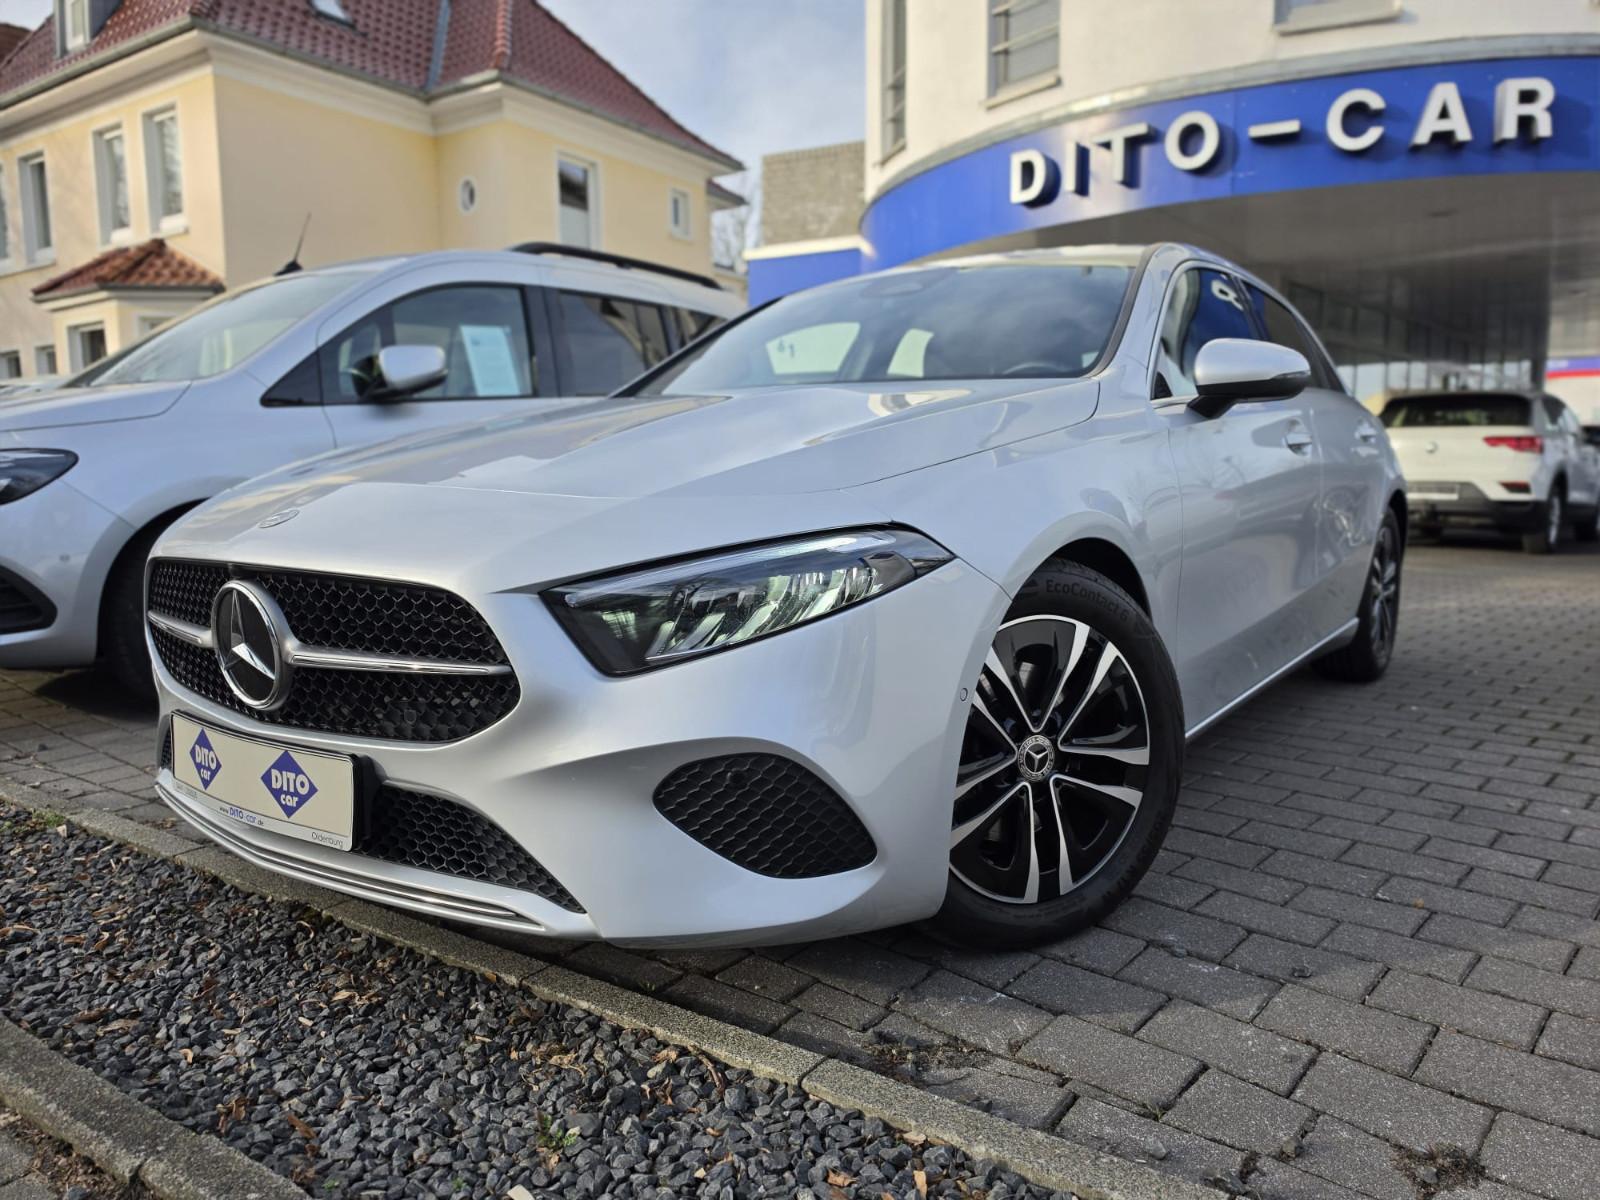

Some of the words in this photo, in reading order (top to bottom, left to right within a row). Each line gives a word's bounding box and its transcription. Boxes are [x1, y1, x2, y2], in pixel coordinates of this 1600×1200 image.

[1045, 579, 1120, 613] EcoContact
[1119, 609, 1130, 622] 6
[195, 745, 217, 770] DITO
[200, 767, 211, 781] car
[271, 768, 310, 795] DITO
[280, 793, 299, 808] car
[311, 831, 344, 849] Oldenburg
